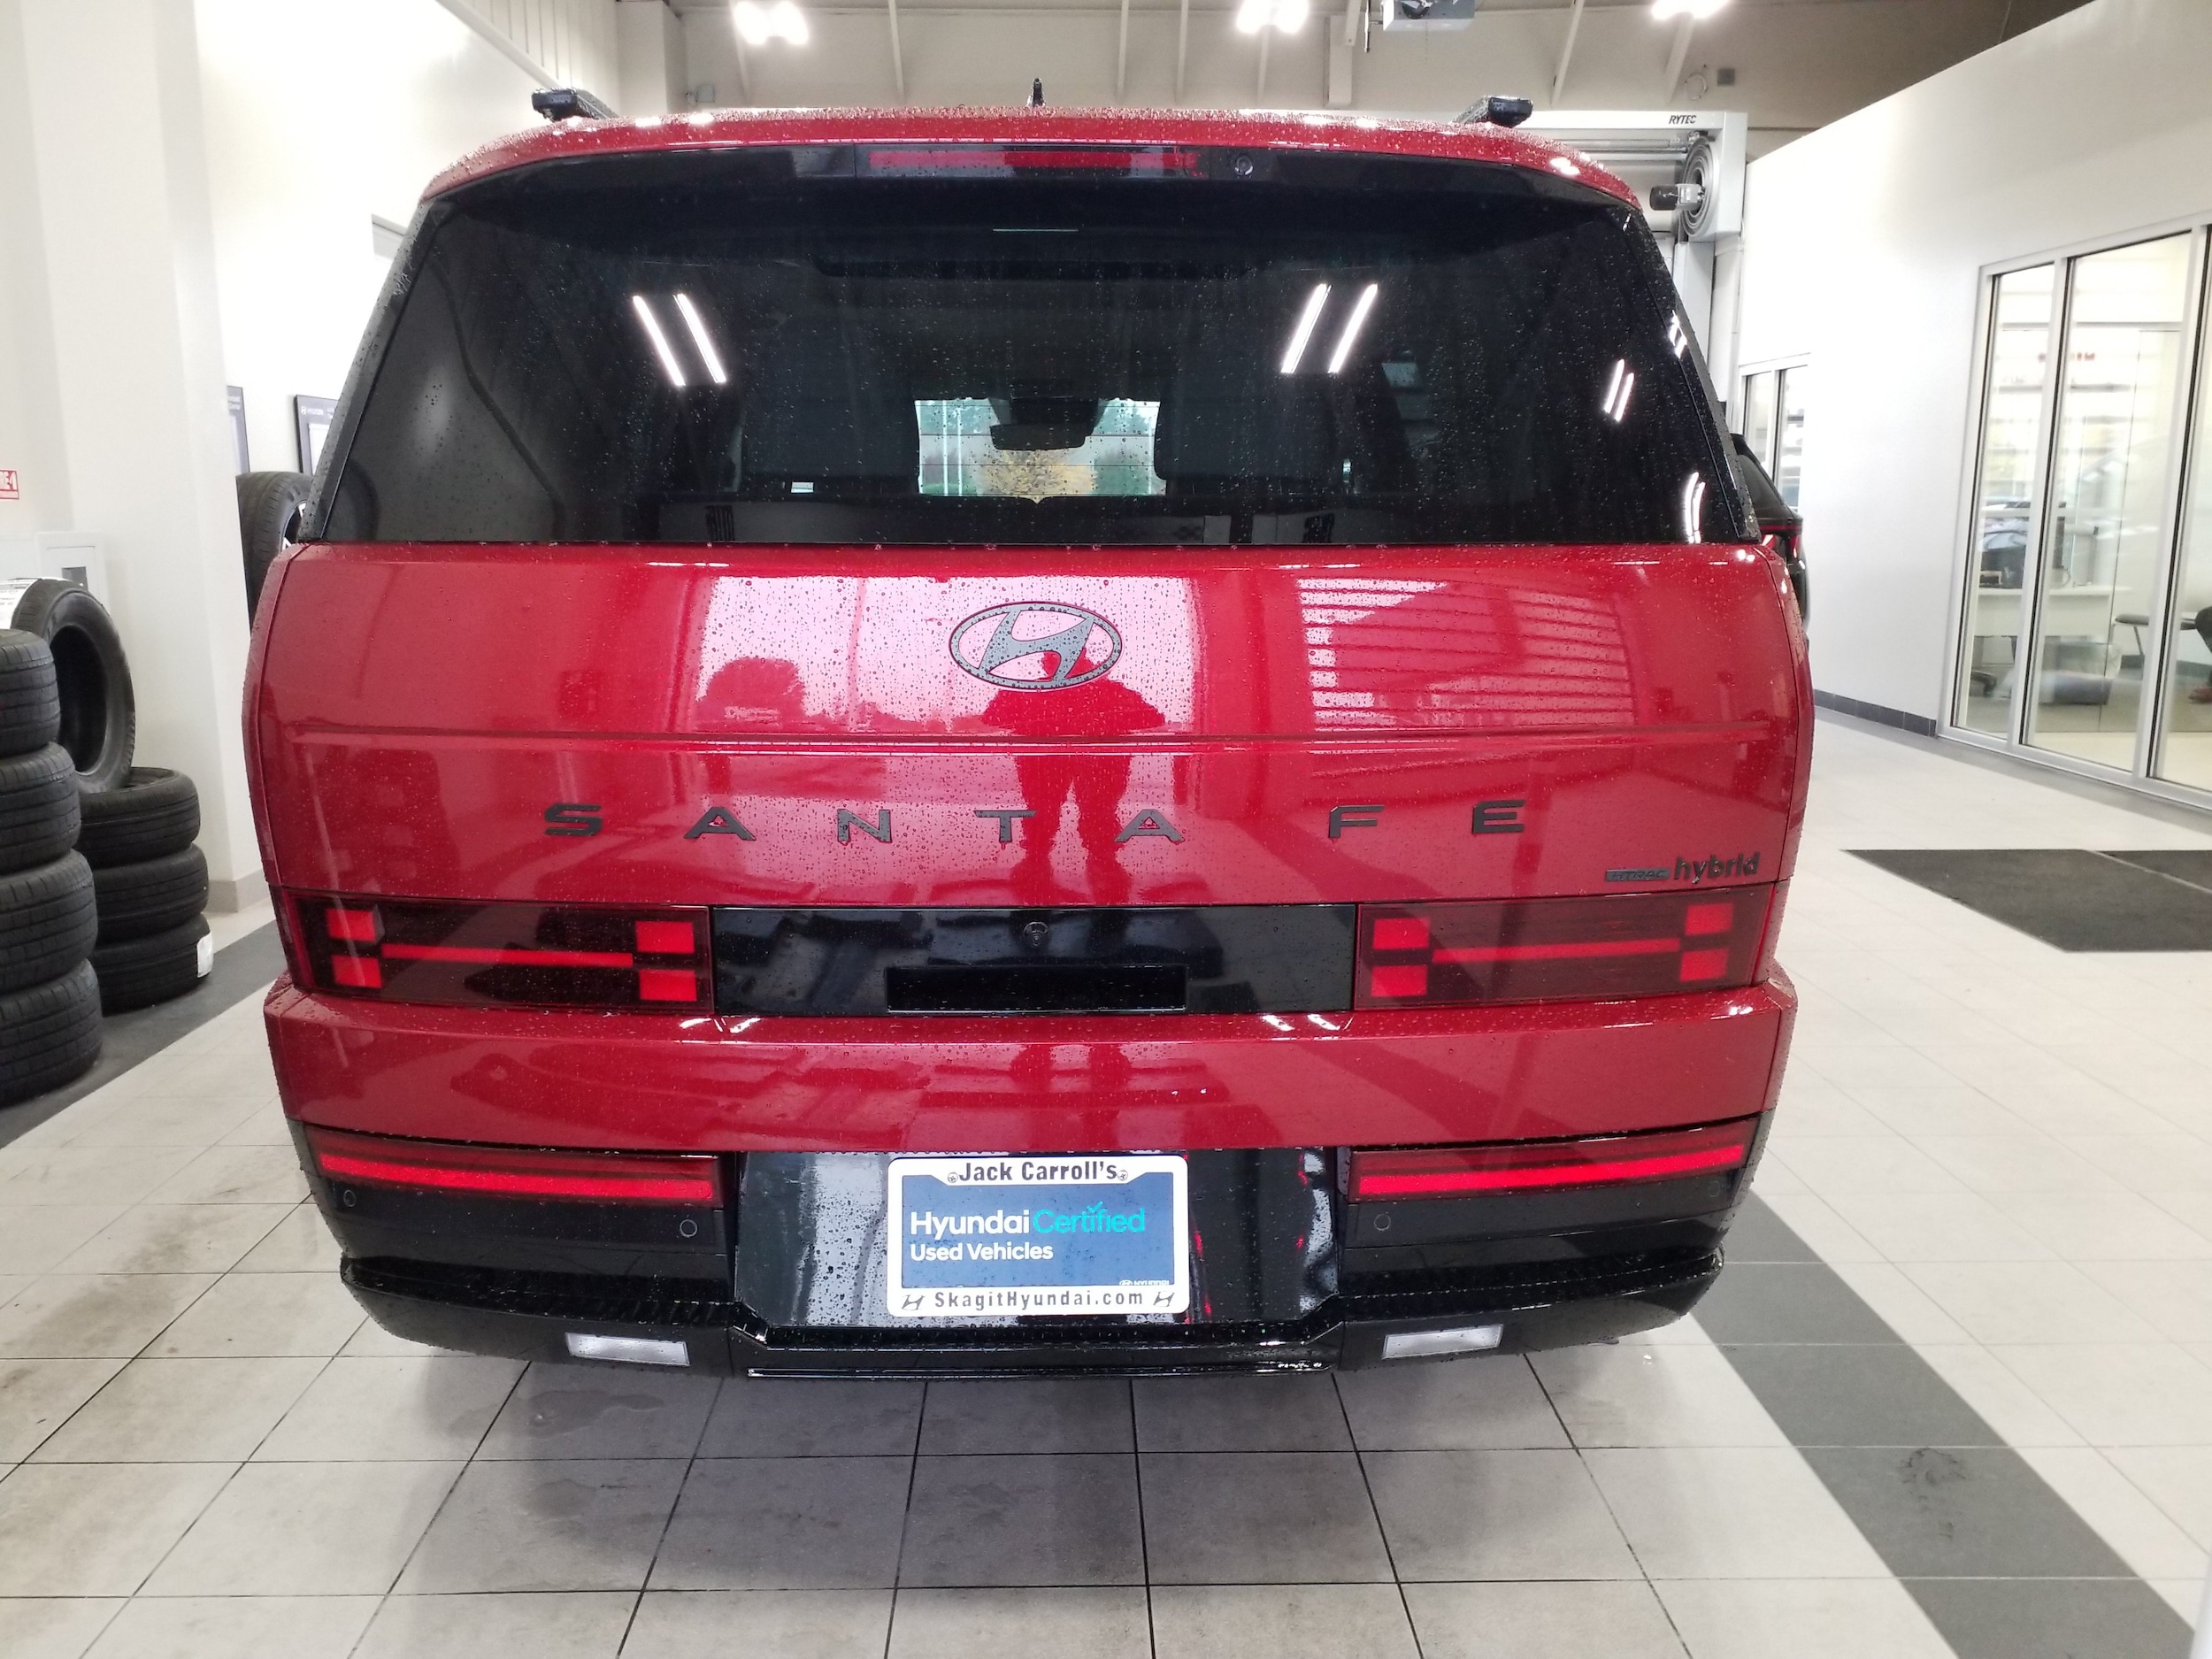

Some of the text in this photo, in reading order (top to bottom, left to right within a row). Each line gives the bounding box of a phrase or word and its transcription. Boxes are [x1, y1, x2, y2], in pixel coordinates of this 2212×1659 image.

[1669, 115, 1696, 124] RYTEC
[544, 799, 1526, 843] SANTA FE
[1612, 852, 1761, 884] HTRAC hybrid
[958, 1161, 1118, 1182] Jack Carroll's
[910, 1201, 1146, 1240] Hyundai Certified
[910, 1242, 1054, 1262] Used Vehicles
[934, 1290, 1144, 1311] SkagitHyundai.com
